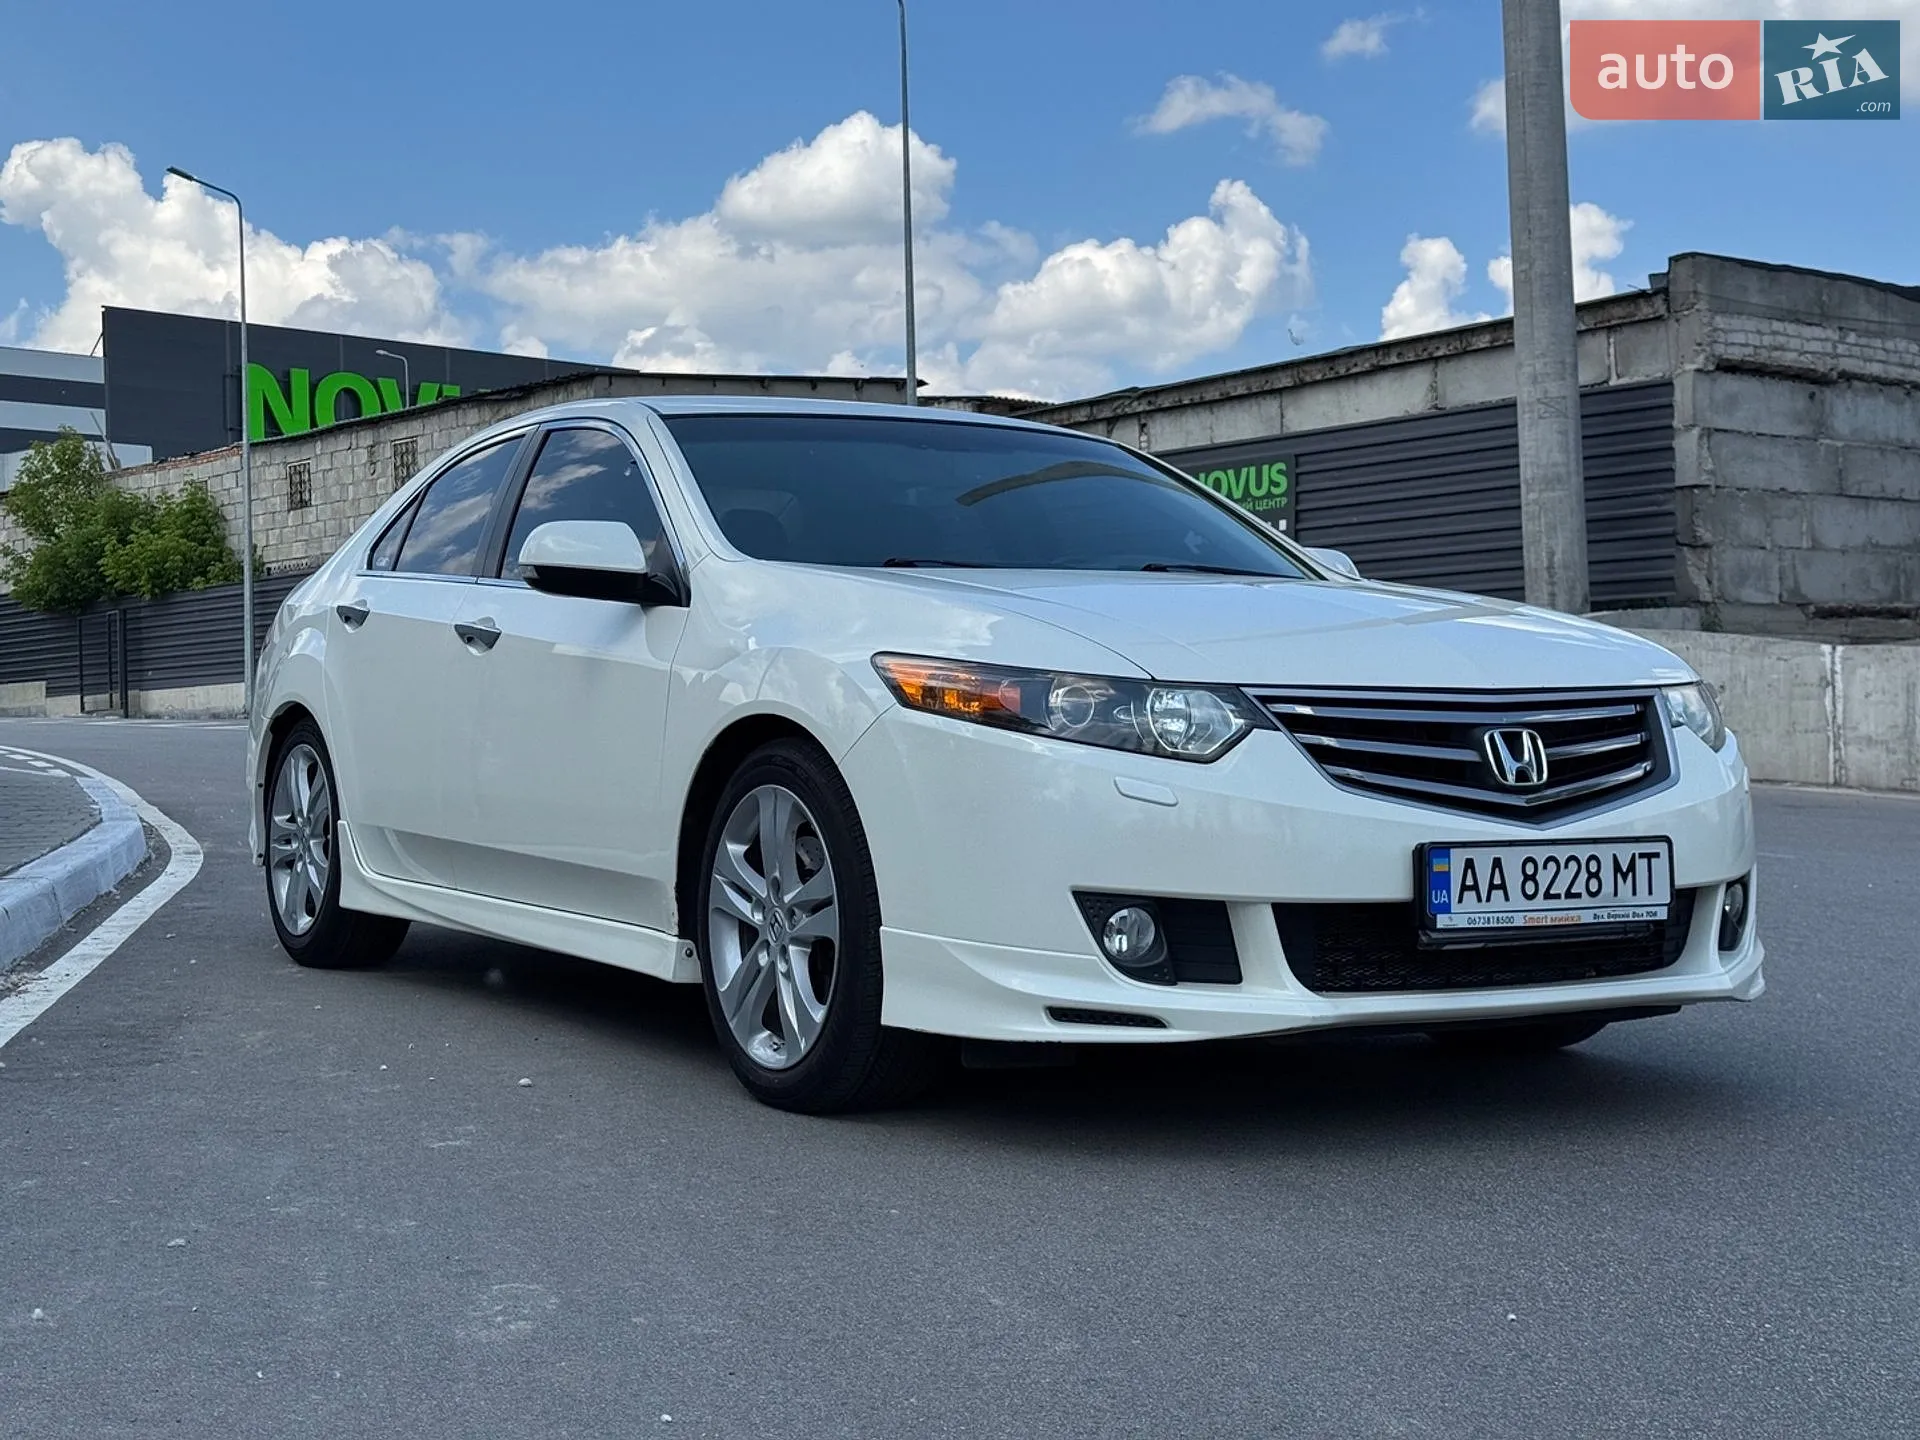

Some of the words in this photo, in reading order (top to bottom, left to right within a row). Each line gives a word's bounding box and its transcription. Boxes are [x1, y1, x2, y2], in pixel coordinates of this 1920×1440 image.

[1457, 856, 1510, 904] AA
[1520, 854, 1602, 901] 8228
[1612, 851, 1661, 897] MT
[1432, 889, 1449, 904] UA
